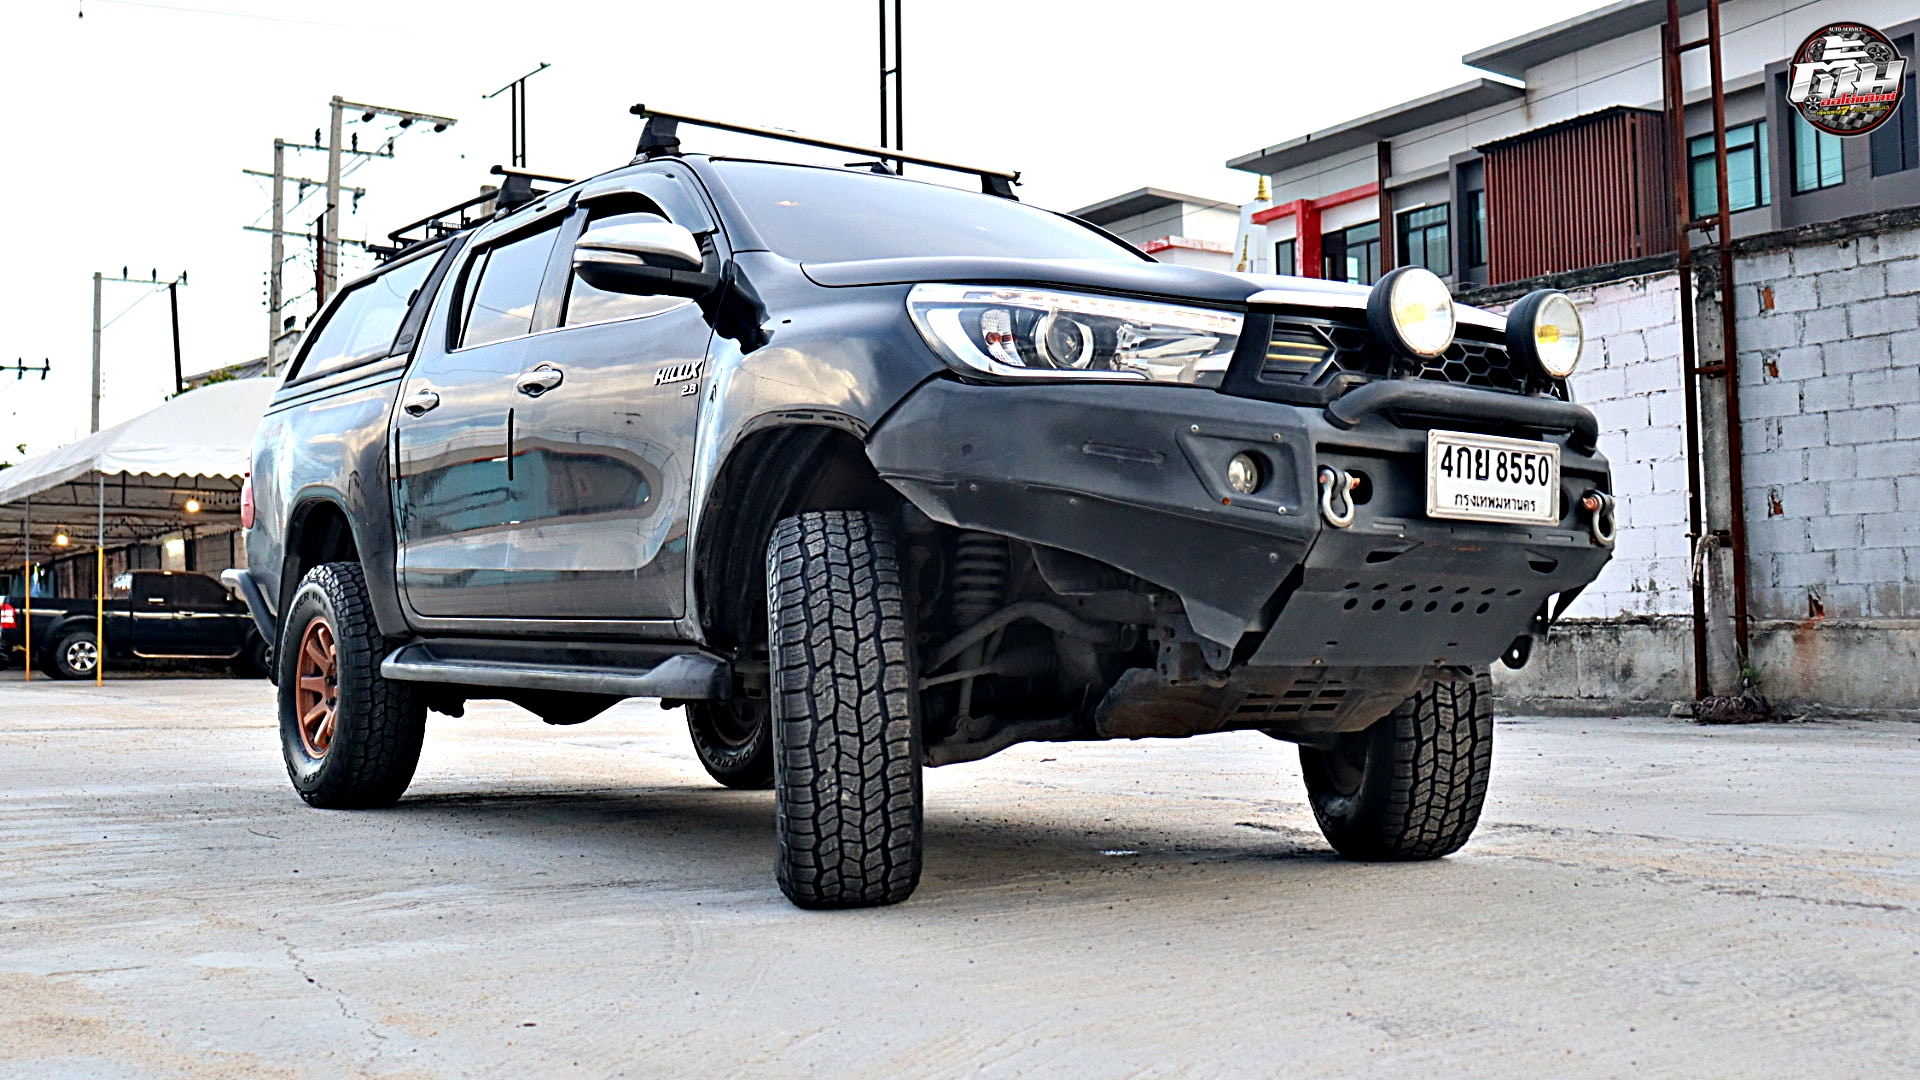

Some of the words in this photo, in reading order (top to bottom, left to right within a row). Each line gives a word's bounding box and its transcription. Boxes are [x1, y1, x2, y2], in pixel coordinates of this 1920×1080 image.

[653, 360, 703, 386] HILUX
[1440, 445, 1490, 481] 4กย
[1496, 451, 1549, 486] 8550
[1454, 493, 1536, 512] กรุงเทพมหานคร
